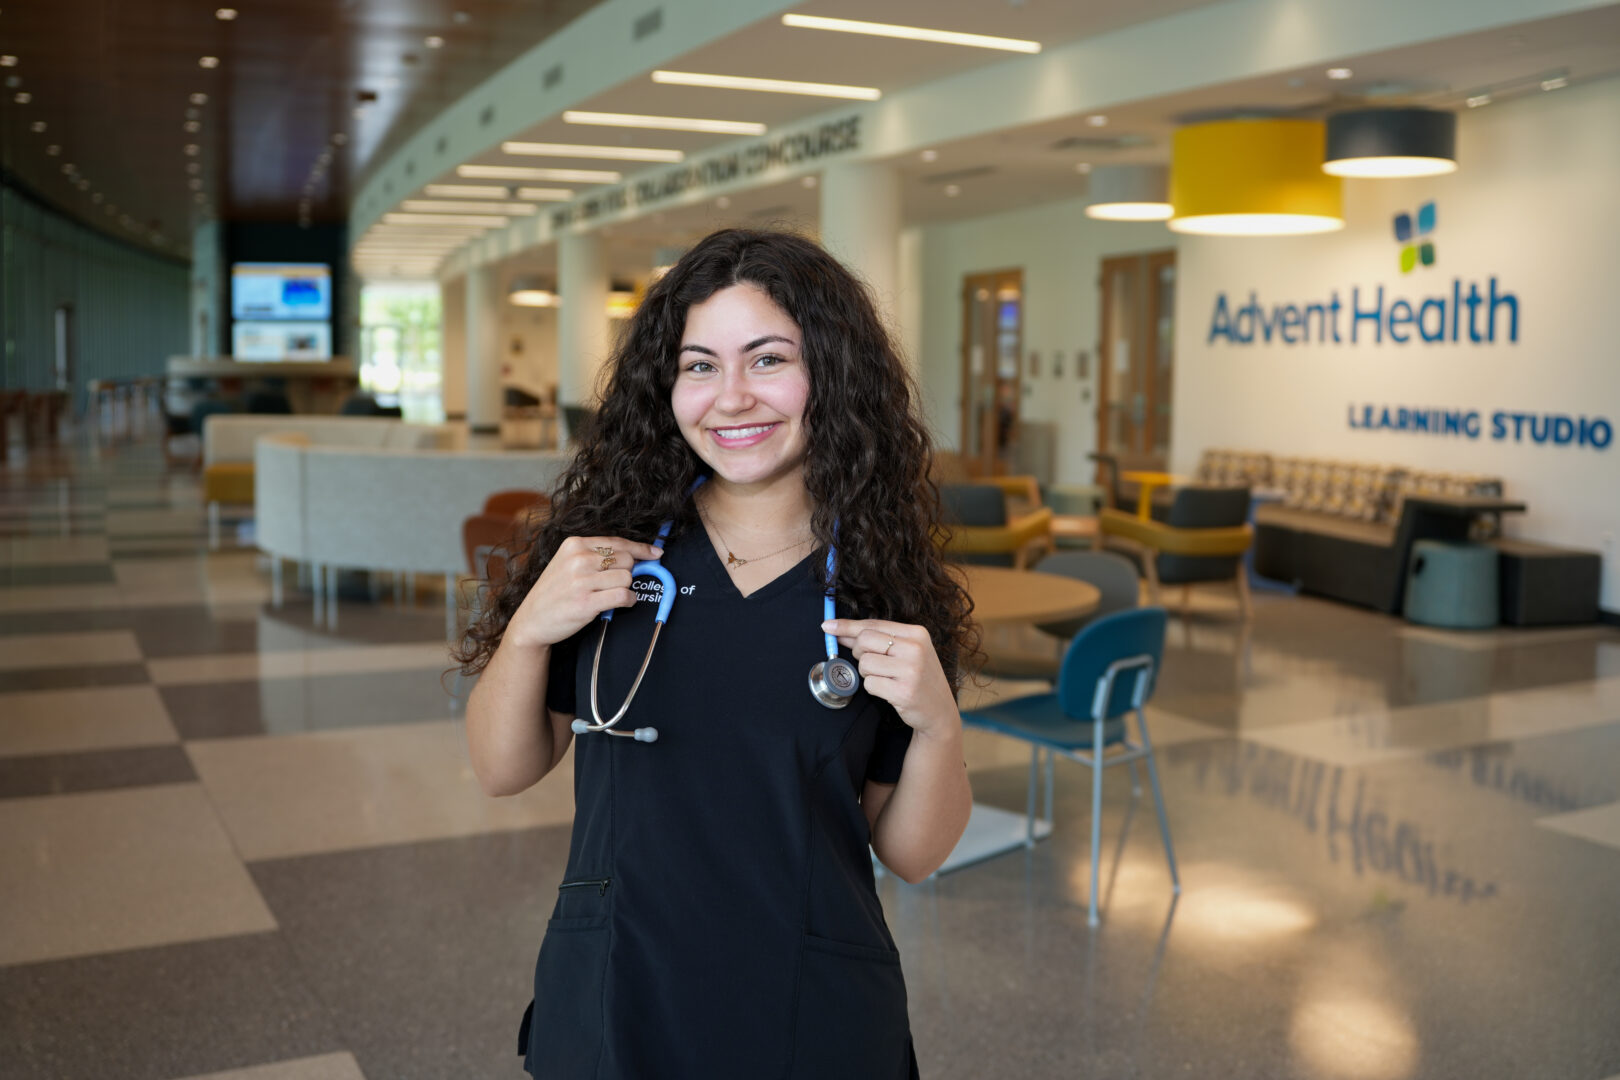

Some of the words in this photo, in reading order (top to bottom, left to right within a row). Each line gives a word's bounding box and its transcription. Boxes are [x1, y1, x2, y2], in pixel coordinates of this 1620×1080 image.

[1348, 404, 1481, 439] LEARNING
[1491, 410, 1613, 450] STUDIO
[680, 585, 697, 595] of
